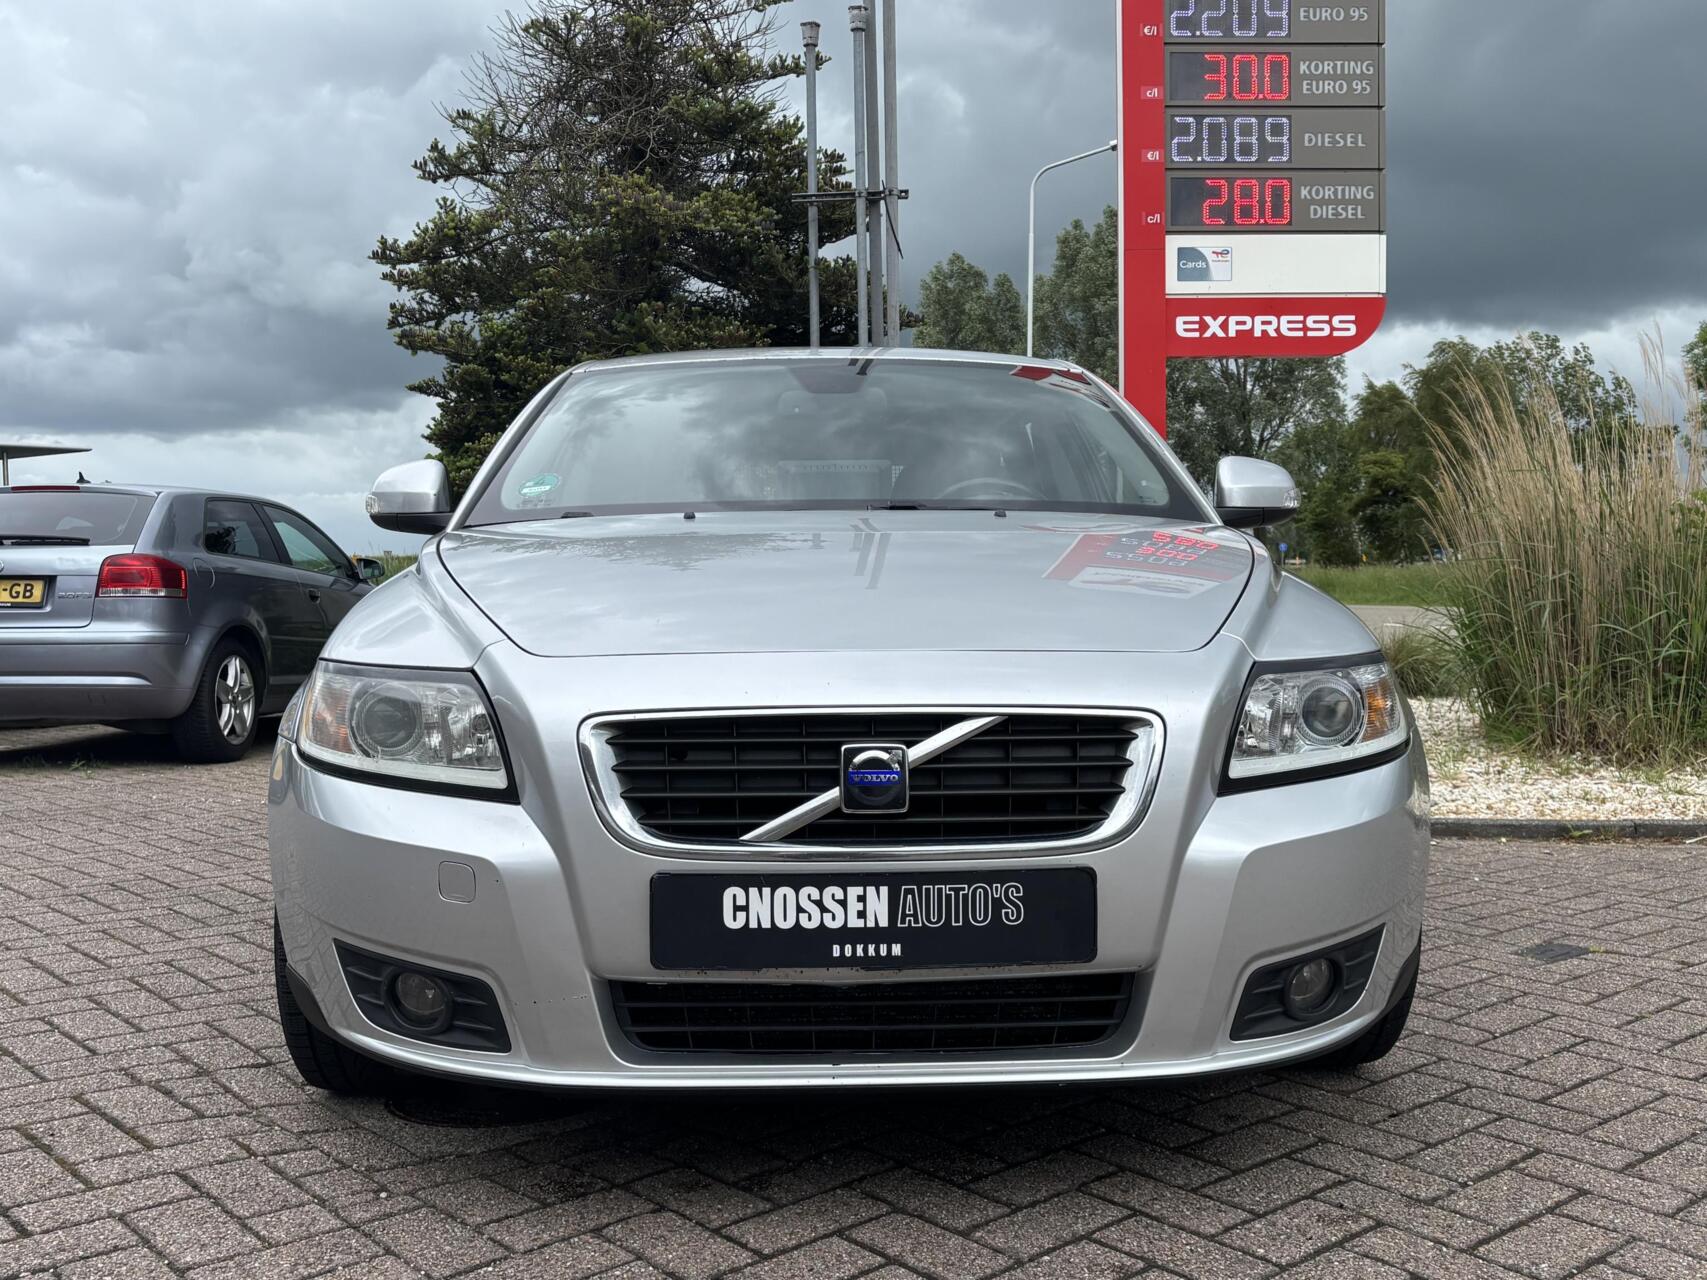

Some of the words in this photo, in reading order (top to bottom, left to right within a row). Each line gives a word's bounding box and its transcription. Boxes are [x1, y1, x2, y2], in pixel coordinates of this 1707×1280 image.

[1300, 7, 1345, 21] EURO
[1350, 7, 1368, 21] 95
[1300, 60, 1374, 75] KORTING
[1204, 54, 1289, 100] 30.0
[1303, 80, 1347, 94] EURO
[1352, 80, 1371, 94] 95
[1171, 117, 1290, 162] 2.089
[1304, 133, 1366, 147] DIESEL
[1301, 186, 1374, 200] KORTING
[1203, 179, 1290, 224] 28.0
[1310, 205, 1365, 219] DIESEL
[1180, 260, 1207, 269] Cards
[1175, 315, 1357, 337] EXPRESS
[851, 774, 899, 782] VOLVO
[722, 885, 889, 929] CNOSSEN
[897, 882, 1024, 927] AUTO'S
[832, 943, 902, 957] DOKKUM
